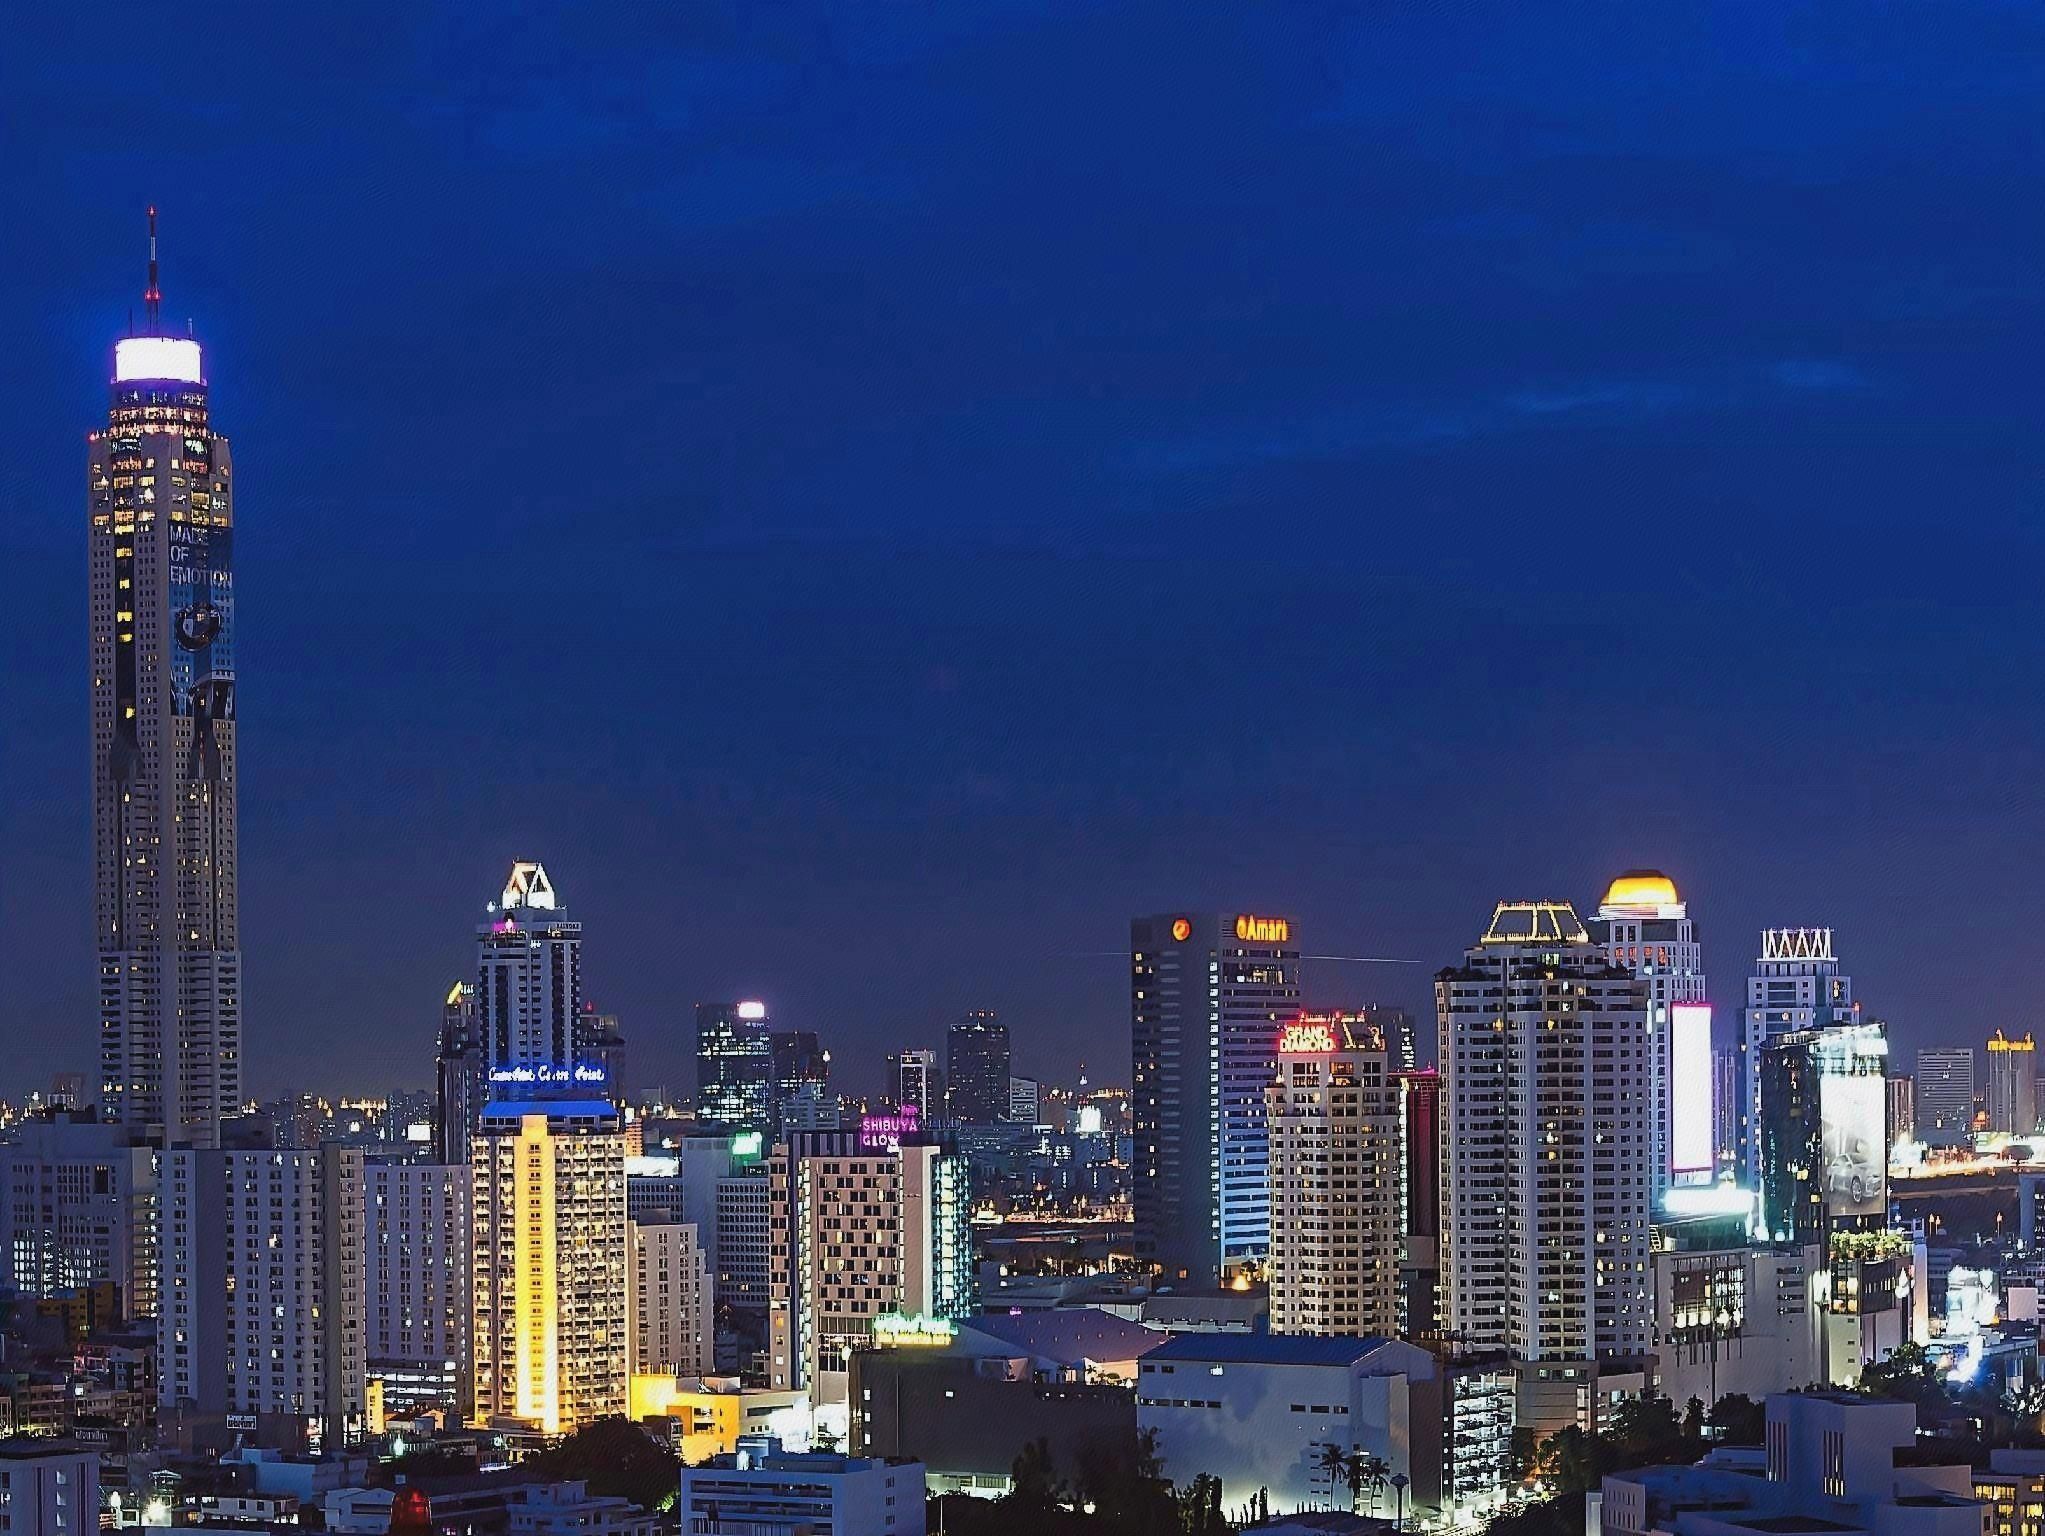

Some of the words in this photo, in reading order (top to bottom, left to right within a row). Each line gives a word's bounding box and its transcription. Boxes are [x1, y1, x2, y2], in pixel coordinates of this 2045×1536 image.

[170, 545, 189, 561] OF
[170, 565, 233, 589] EMOTION
[1246, 914, 1288, 942] Amari
[1286, 1026, 1328, 1040] GRAND
[1280, 1038, 1334, 1052] DIAMOND
[862, 1117, 918, 1132] SHIBUYA
